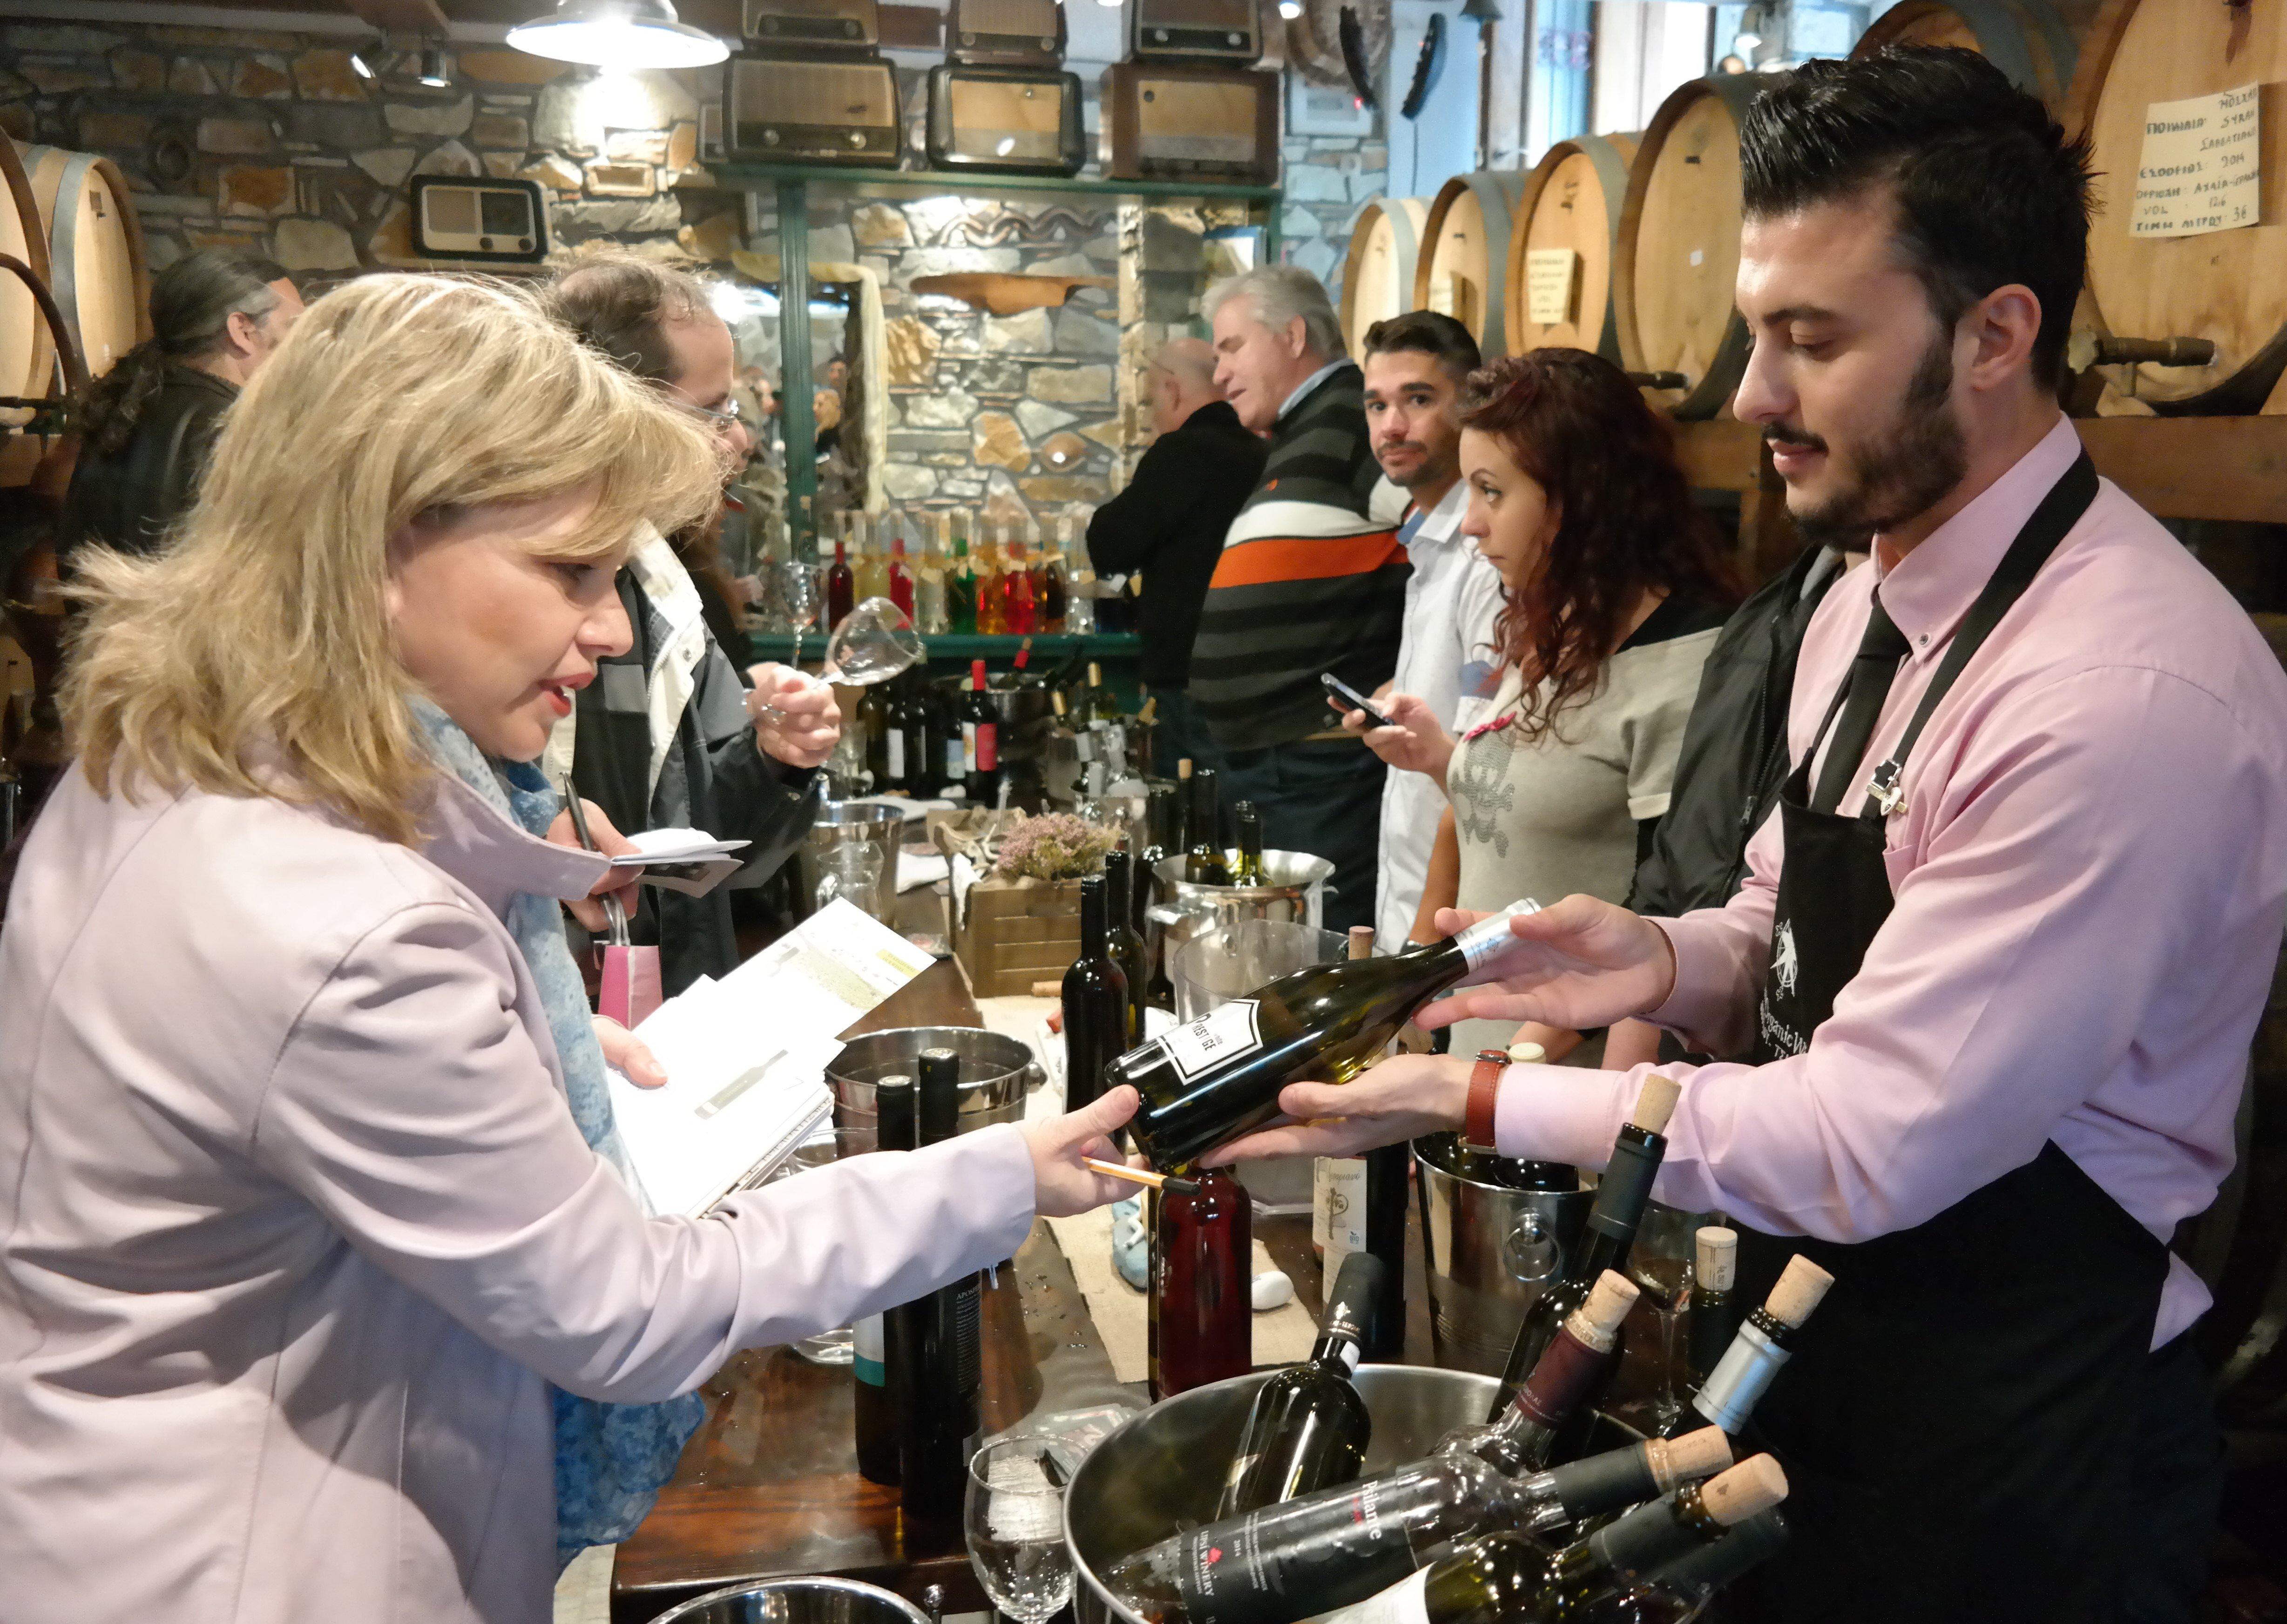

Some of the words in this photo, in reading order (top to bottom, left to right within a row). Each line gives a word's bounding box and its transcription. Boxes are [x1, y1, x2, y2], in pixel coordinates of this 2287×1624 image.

[2144, 204, 2168, 215] VOL
[1187, 1012, 1216, 1051] PRESTIGE
[1200, 1550, 1214, 1596] WINERY
